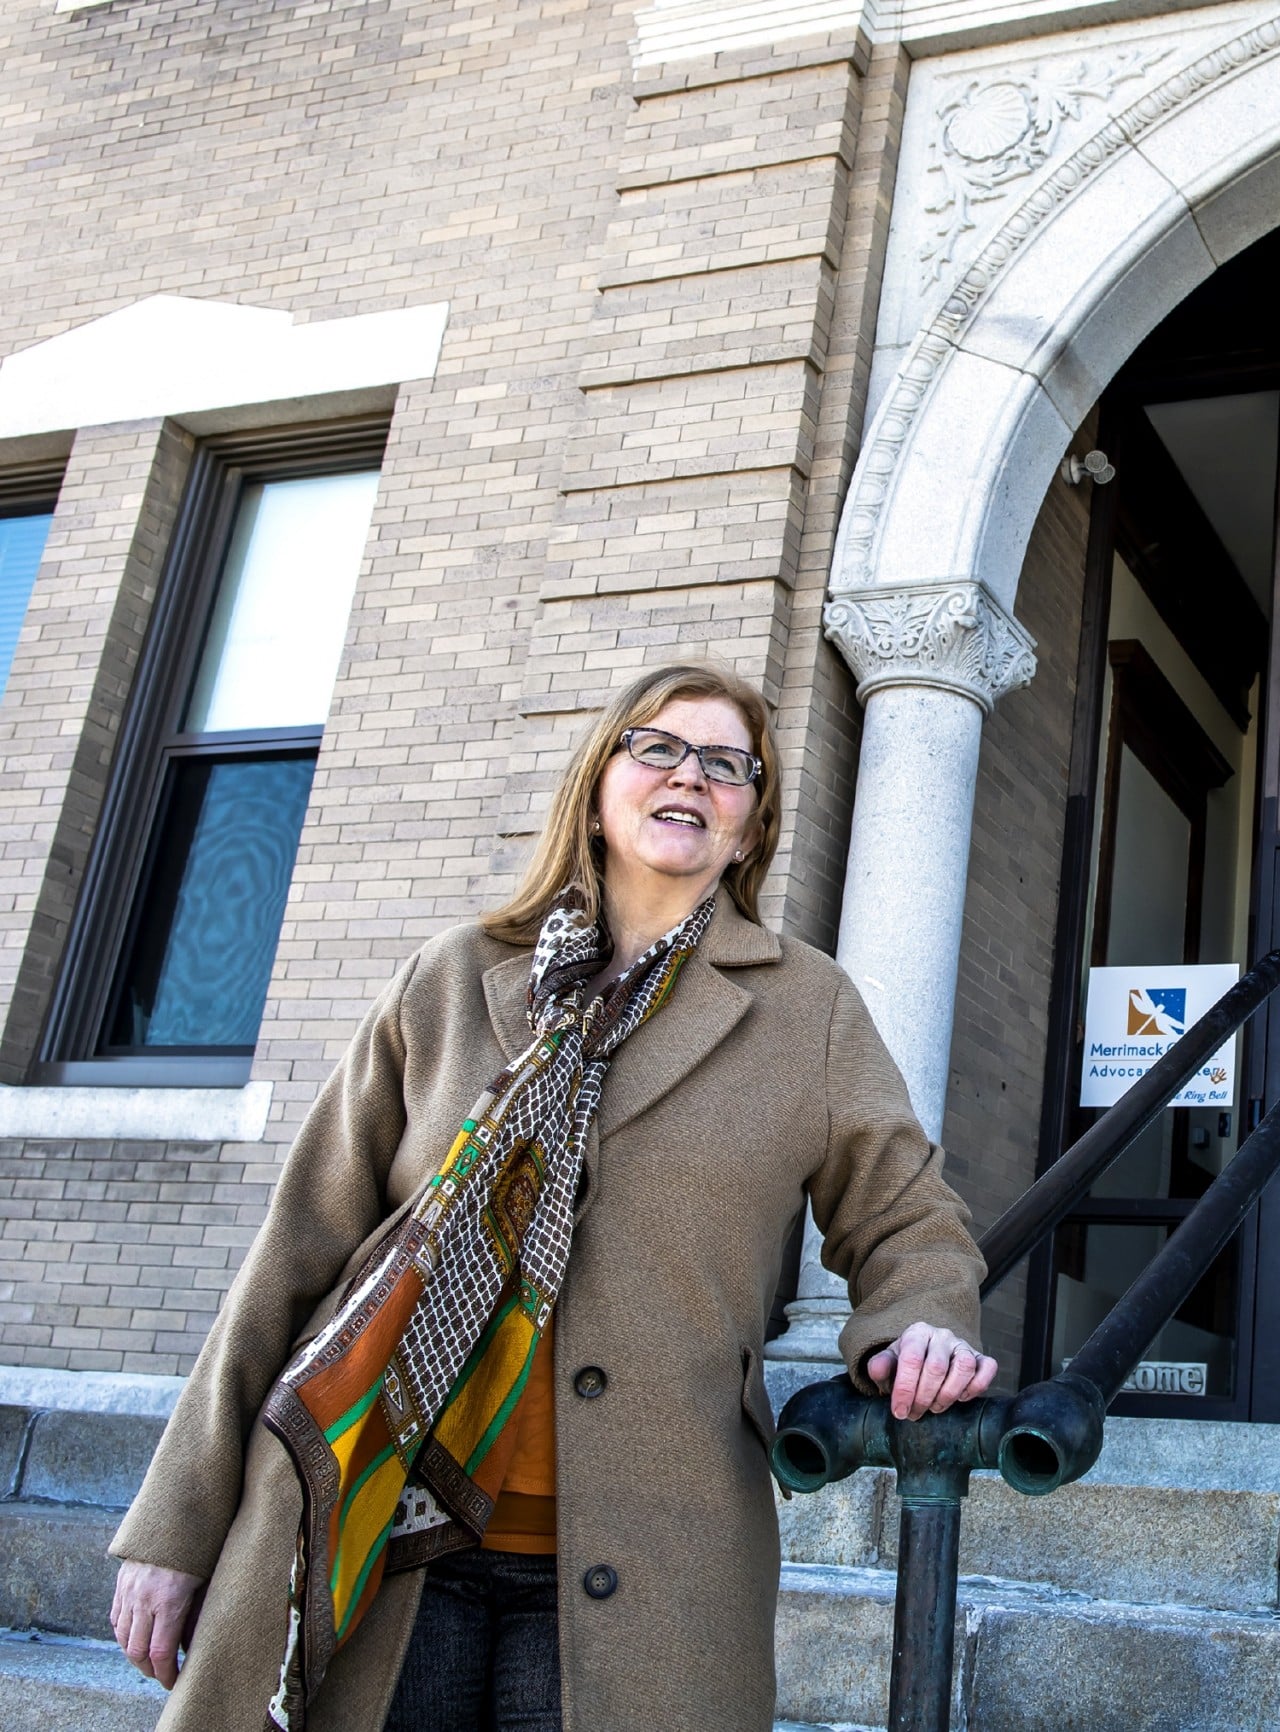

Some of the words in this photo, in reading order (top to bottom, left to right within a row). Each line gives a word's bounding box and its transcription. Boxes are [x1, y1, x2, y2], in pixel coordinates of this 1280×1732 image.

[1090, 1043, 1163, 1056] Merrimack
[1184, 1091, 1206, 1102] Ring
[1208, 1090, 1227, 1100] Bell
